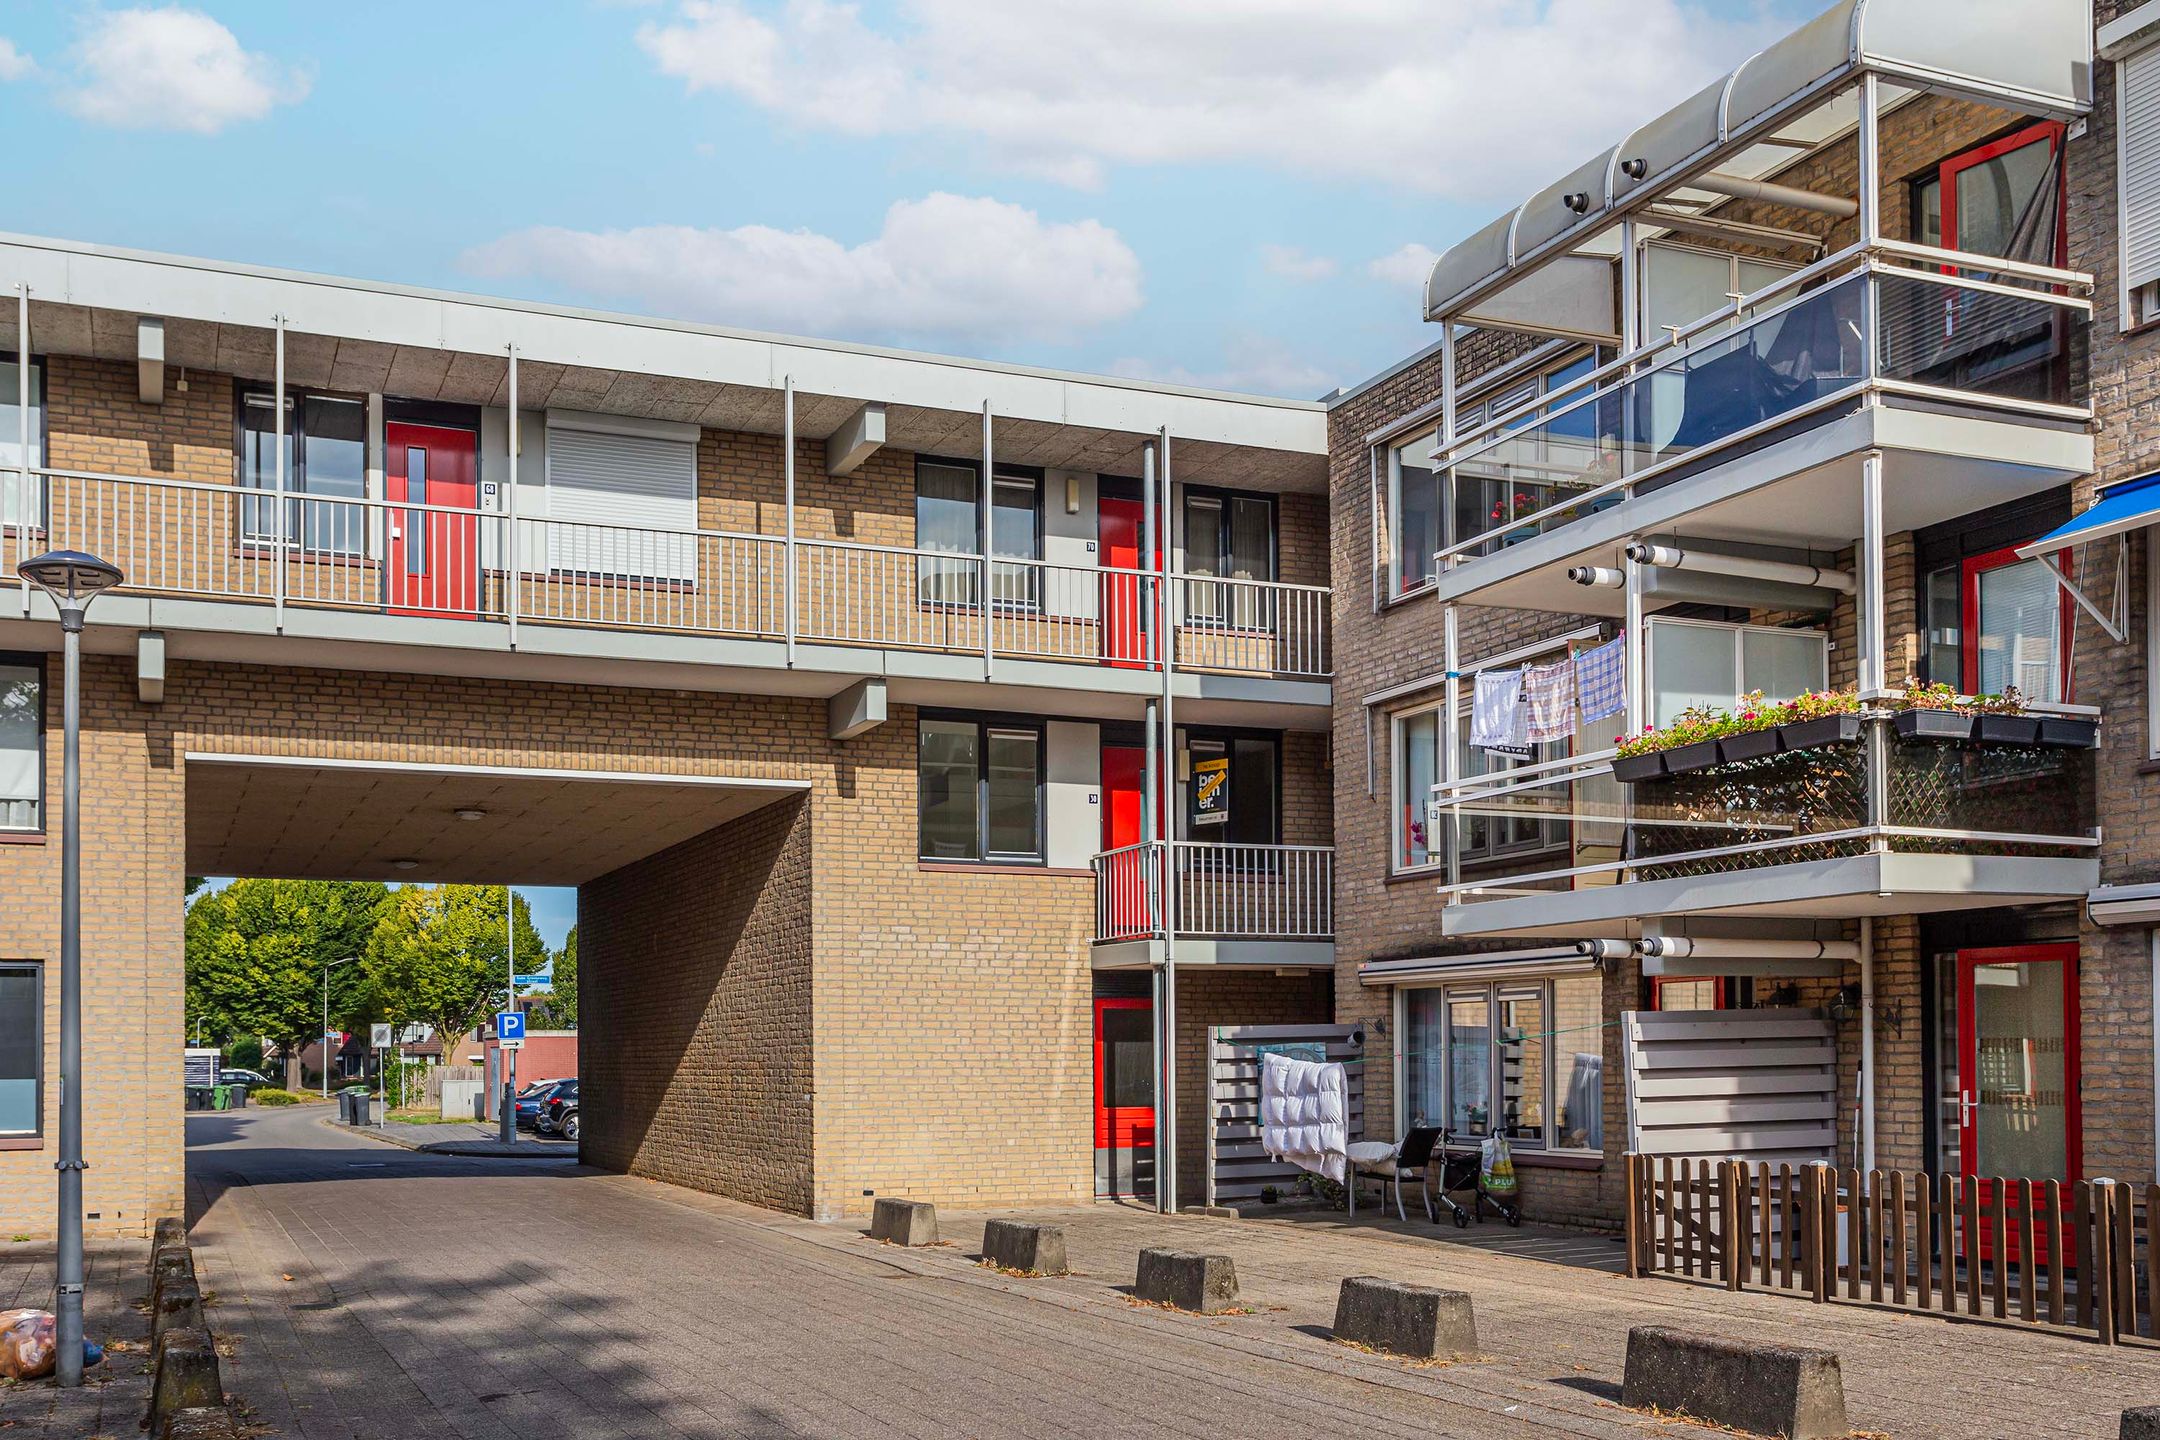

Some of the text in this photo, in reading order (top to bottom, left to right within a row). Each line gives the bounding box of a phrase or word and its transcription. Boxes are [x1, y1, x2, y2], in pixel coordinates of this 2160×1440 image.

[486, 485, 495, 494] 68
[1087, 542, 1095, 551] 70
[504, 1016, 519, 1036] P
